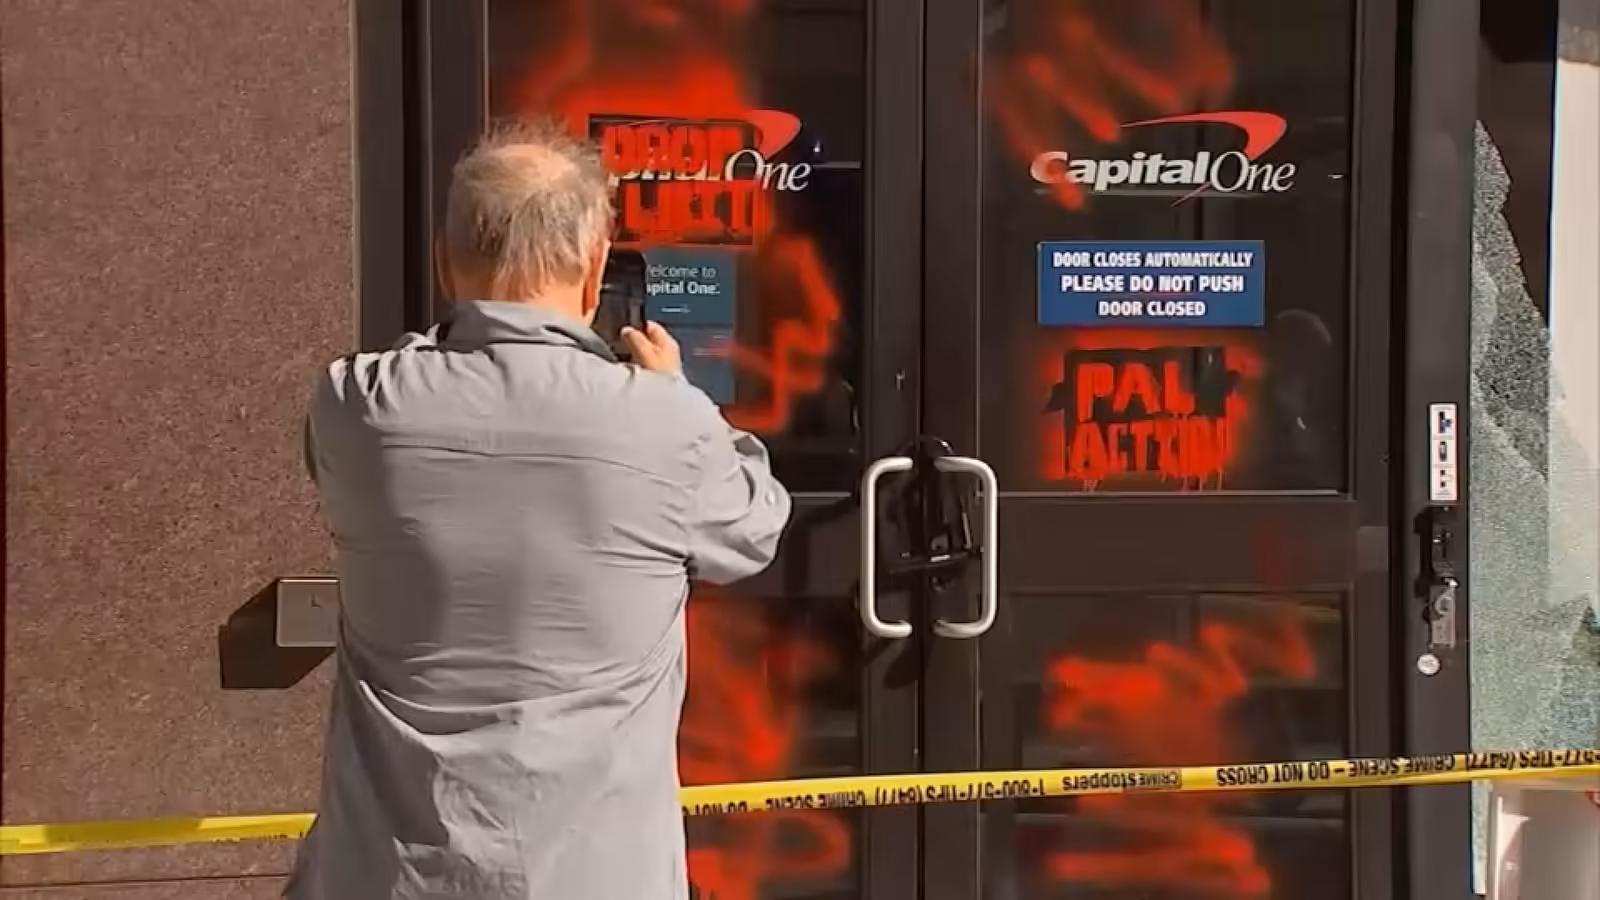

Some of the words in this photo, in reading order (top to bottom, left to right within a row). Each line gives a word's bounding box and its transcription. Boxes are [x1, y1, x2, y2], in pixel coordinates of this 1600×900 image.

[1053, 252, 1090, 268] DOOR
[1094, 252, 1141, 268] CLOSES
[1145, 252, 1253, 268] AUTOMATICALLY
[702, 266, 716, 279] to
[1061, 275, 1125, 293] PLEASE
[1129, 275, 1153, 293] DO
[1158, 275, 1194, 293] NOT
[1199, 275, 1244, 293] PUSH
[1098, 301, 1142, 317] DOOR
[1146, 301, 1206, 317] CLOSED
[1077, 361, 1196, 422] PAL
[1309, 761, 1330, 781] DO
[1348, 760, 1399, 778] SCENE
[1404, 754, 1454, 774] CRIME
[1216, 766, 1269, 787] CROSS
[1273, 764, 1302, 783] NOT
